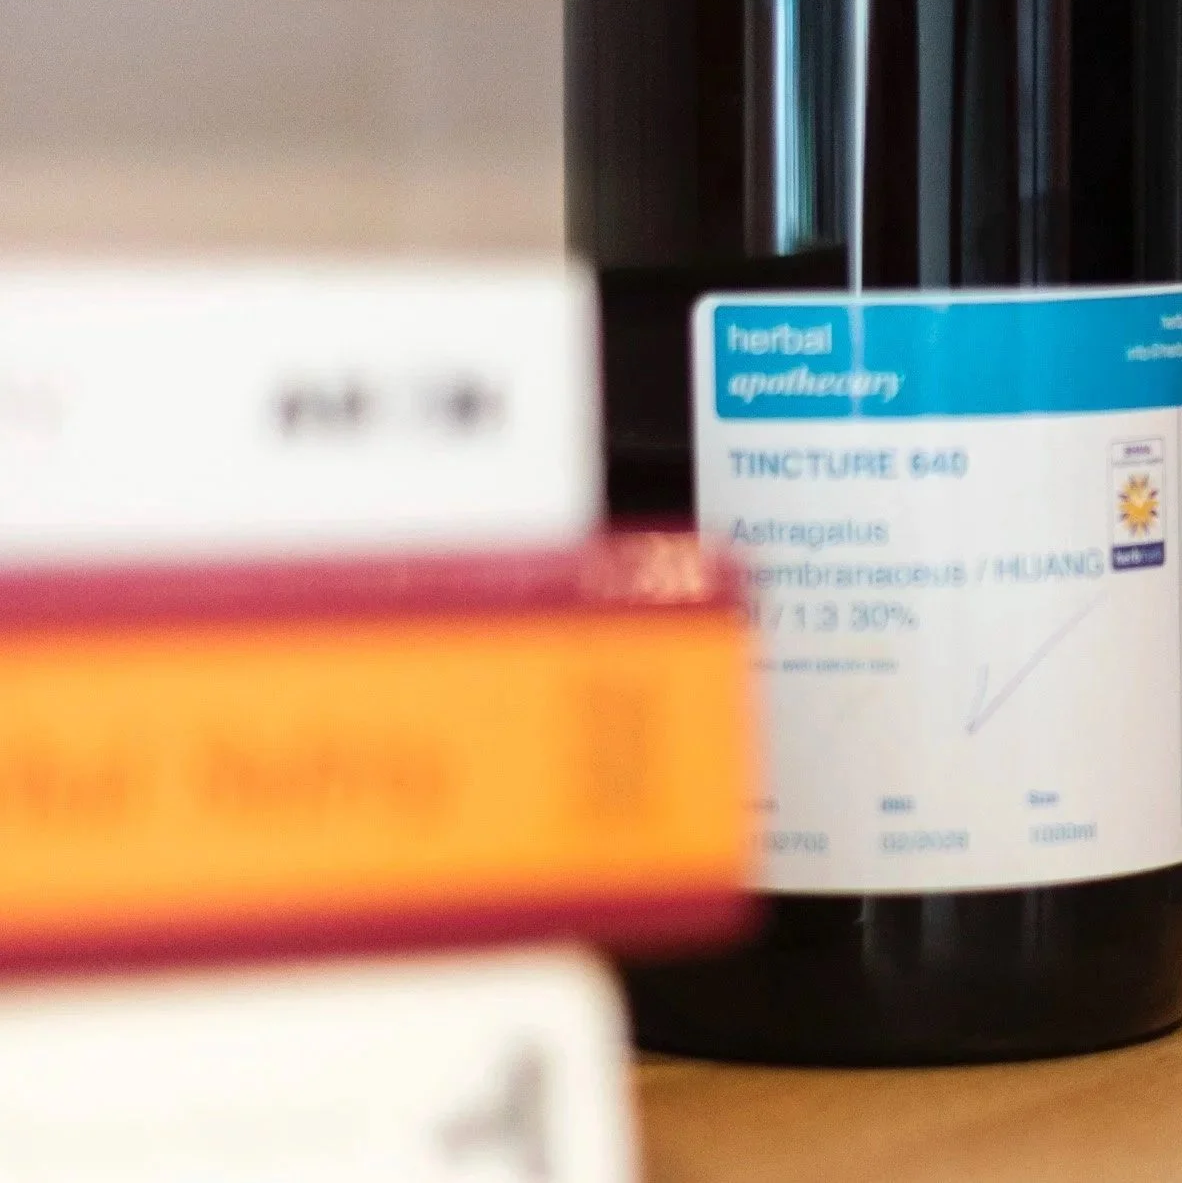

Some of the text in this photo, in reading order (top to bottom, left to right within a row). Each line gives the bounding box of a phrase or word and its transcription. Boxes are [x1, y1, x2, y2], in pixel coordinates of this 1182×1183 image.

[727, 322, 833, 355] herbal
[728, 363, 905, 404] apothecary
[728, 448, 899, 480] TINCTURE
[731, 516, 889, 549] Astragalus
[994, 547, 1105, 583] HUANG
[850, 600, 920, 633] 30%
